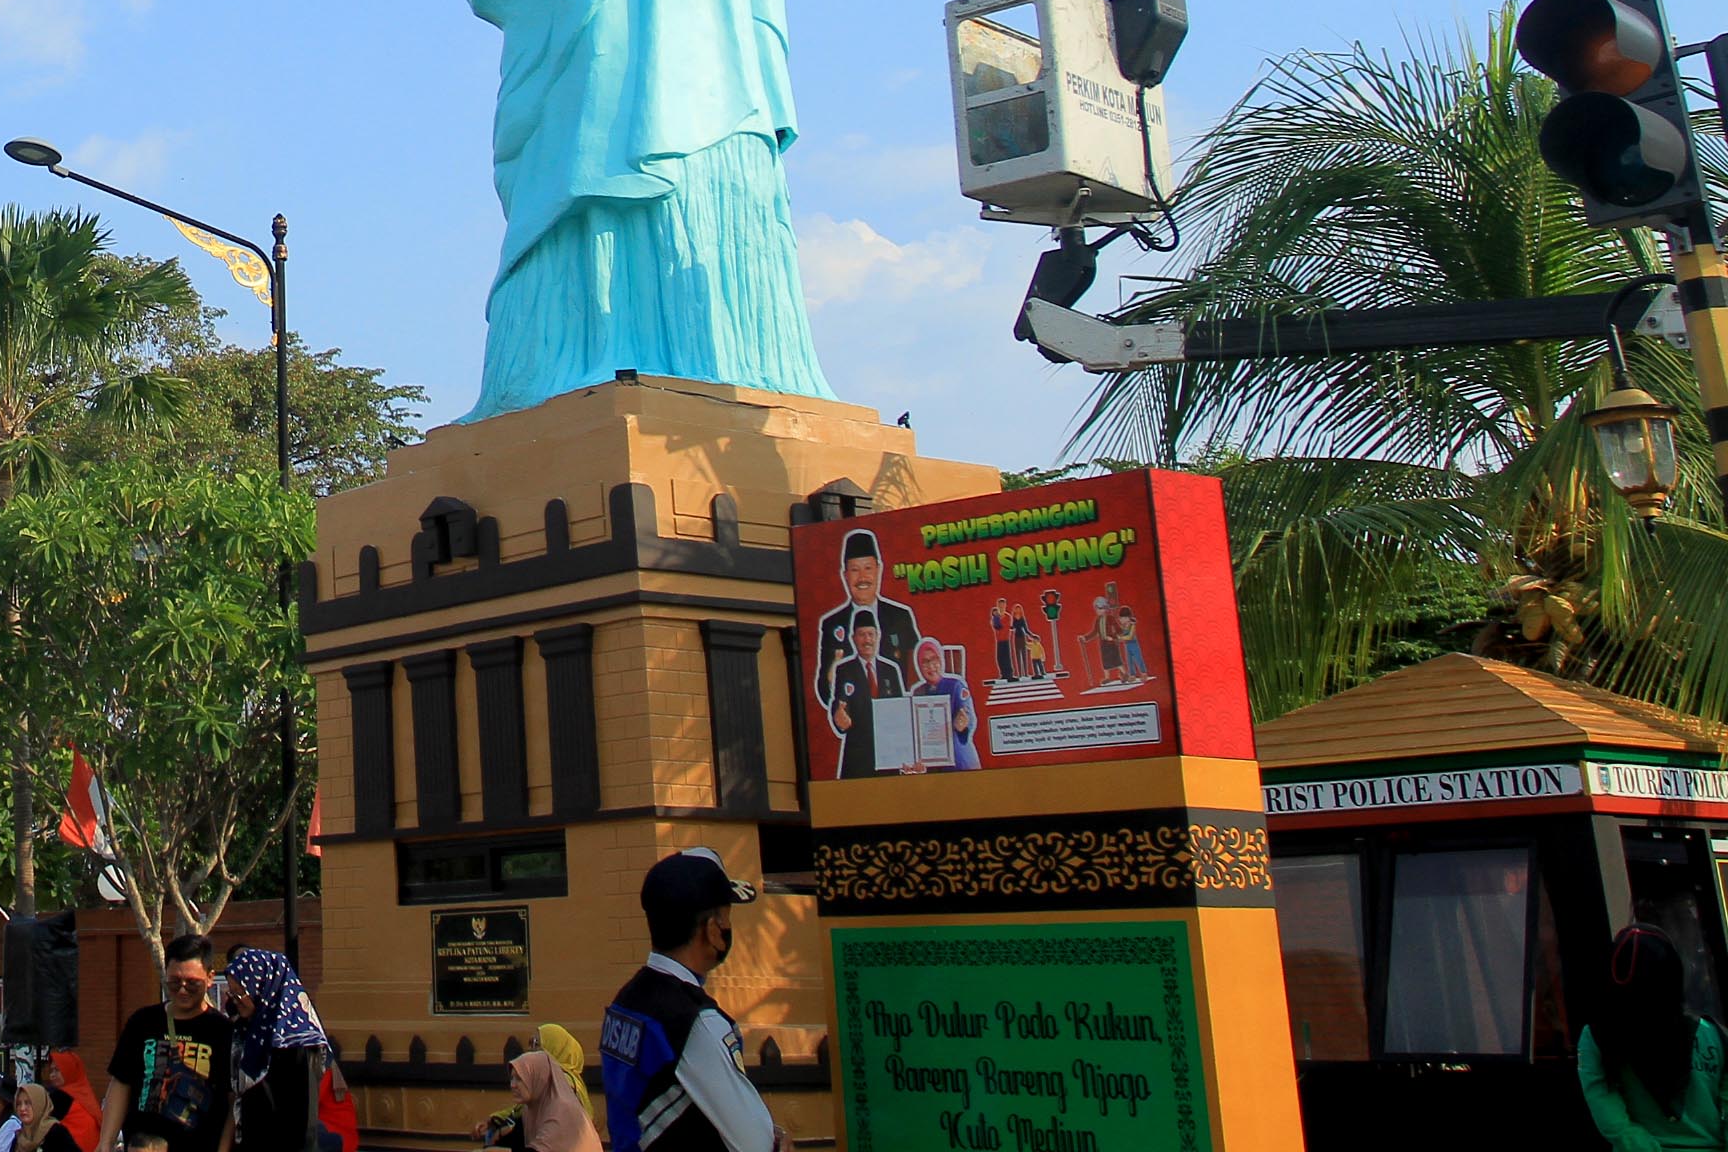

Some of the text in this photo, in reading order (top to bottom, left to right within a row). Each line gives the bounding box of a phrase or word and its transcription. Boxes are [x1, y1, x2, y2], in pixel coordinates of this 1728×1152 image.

[1066, 71, 1162, 126] PERKIM KOTA MIUN
[1079, 99, 1108, 119] HOTLINE
[920, 499, 1098, 548] PENYEBRANGAN
[893, 528, 1137, 595] "KASIH SAYANG"
[1333, 775, 1433, 808] POLICE
[1440, 766, 1566, 802] STATION
[1612, 766, 1682, 797] TOURIST
[164, 1034, 192, 1042] WYANG
[865, 1000, 1163, 1052] Ayo Dulur Podo Rukun,
[884, 1054, 1152, 1117] Bareng Bareng Njogo
[940, 1111, 1003, 1151] Kuto
